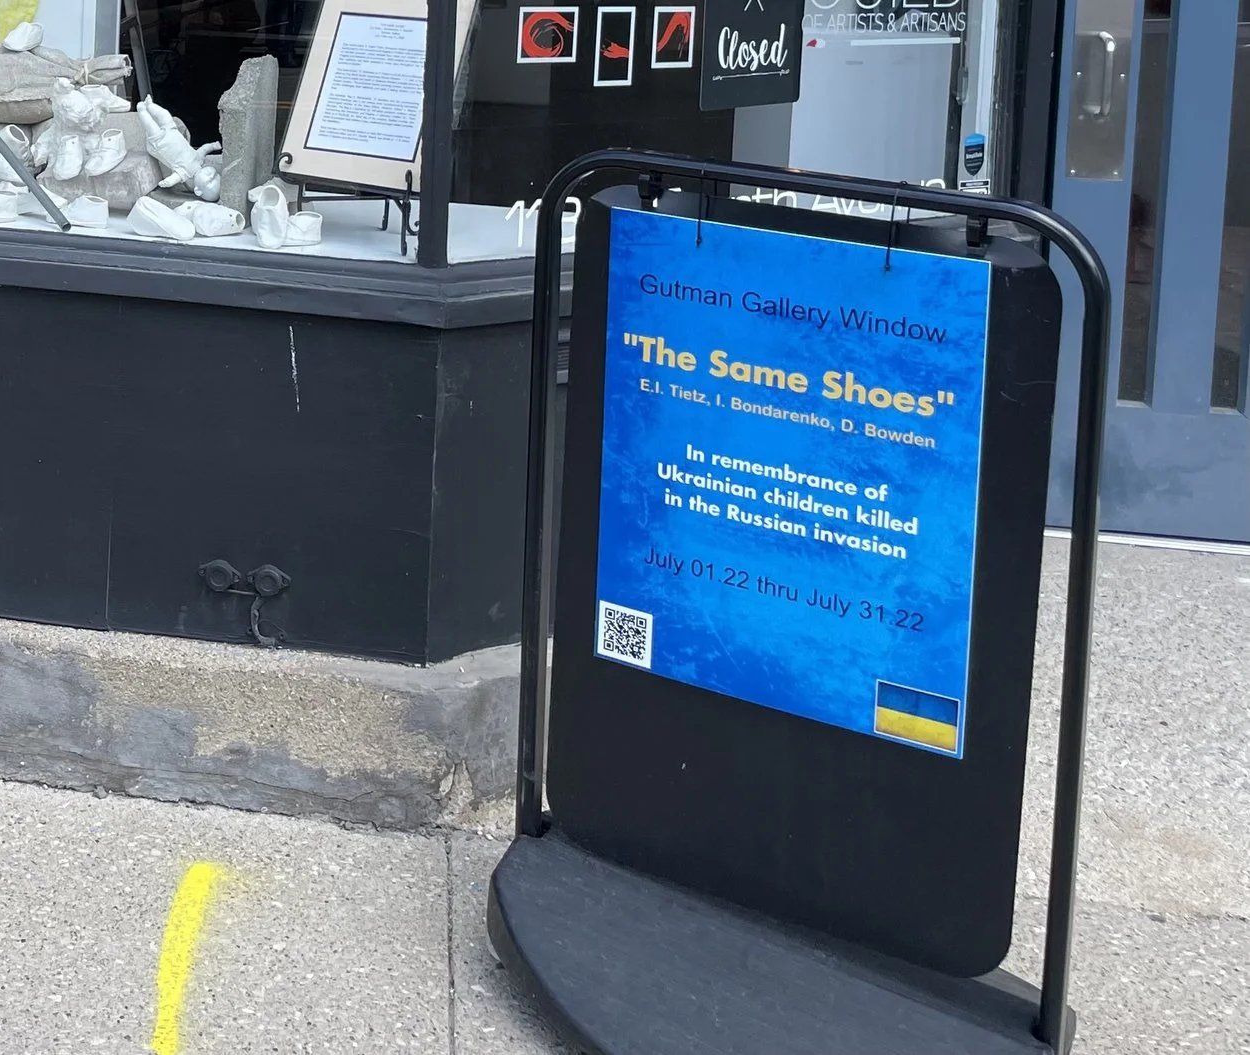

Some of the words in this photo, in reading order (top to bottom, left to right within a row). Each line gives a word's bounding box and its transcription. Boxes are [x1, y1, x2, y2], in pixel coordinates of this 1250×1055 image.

[718, 23, 788, 71] Closed
[802, 14, 823, 31] OF
[826, 13, 885, 33] ARTISTS
[887, 12, 898, 32] &
[900, 12, 966, 32] ARTISANS
[639, 274, 732, 309] Gutman
[742, 291, 831, 330] Gallery
[839, 306, 947, 344] Window
[623, 332, 697, 372] "The
[709, 349, 809, 394] Same
[822, 370, 955, 417] Shoes"
[640, 378, 664, 395] E.I.
[669, 384, 711, 406] Tietz,
[716, 393, 726, 408] I.
[731, 396, 835, 432] Bondarenko,
[841, 418, 858, 434] D.
[865, 423, 936, 449] Bowden
[657, 462, 757, 500] Ukrainian
[763, 487, 849, 520] children
[856, 505, 919, 536] killed
[686, 443, 705, 463] In
[711, 453, 858, 496] remembrance
[864, 484, 889, 502] of
[664, 488, 682, 508] in
[689, 495, 721, 517] the
[726, 503, 807, 537] Russian
[813, 522, 907, 559] invasion
[644, 547, 684, 576] July
[691, 559, 750, 590] 01.22
[757, 576, 798, 602] thru
[806, 588, 851, 618] July
[859, 600, 925, 633] 31.22
